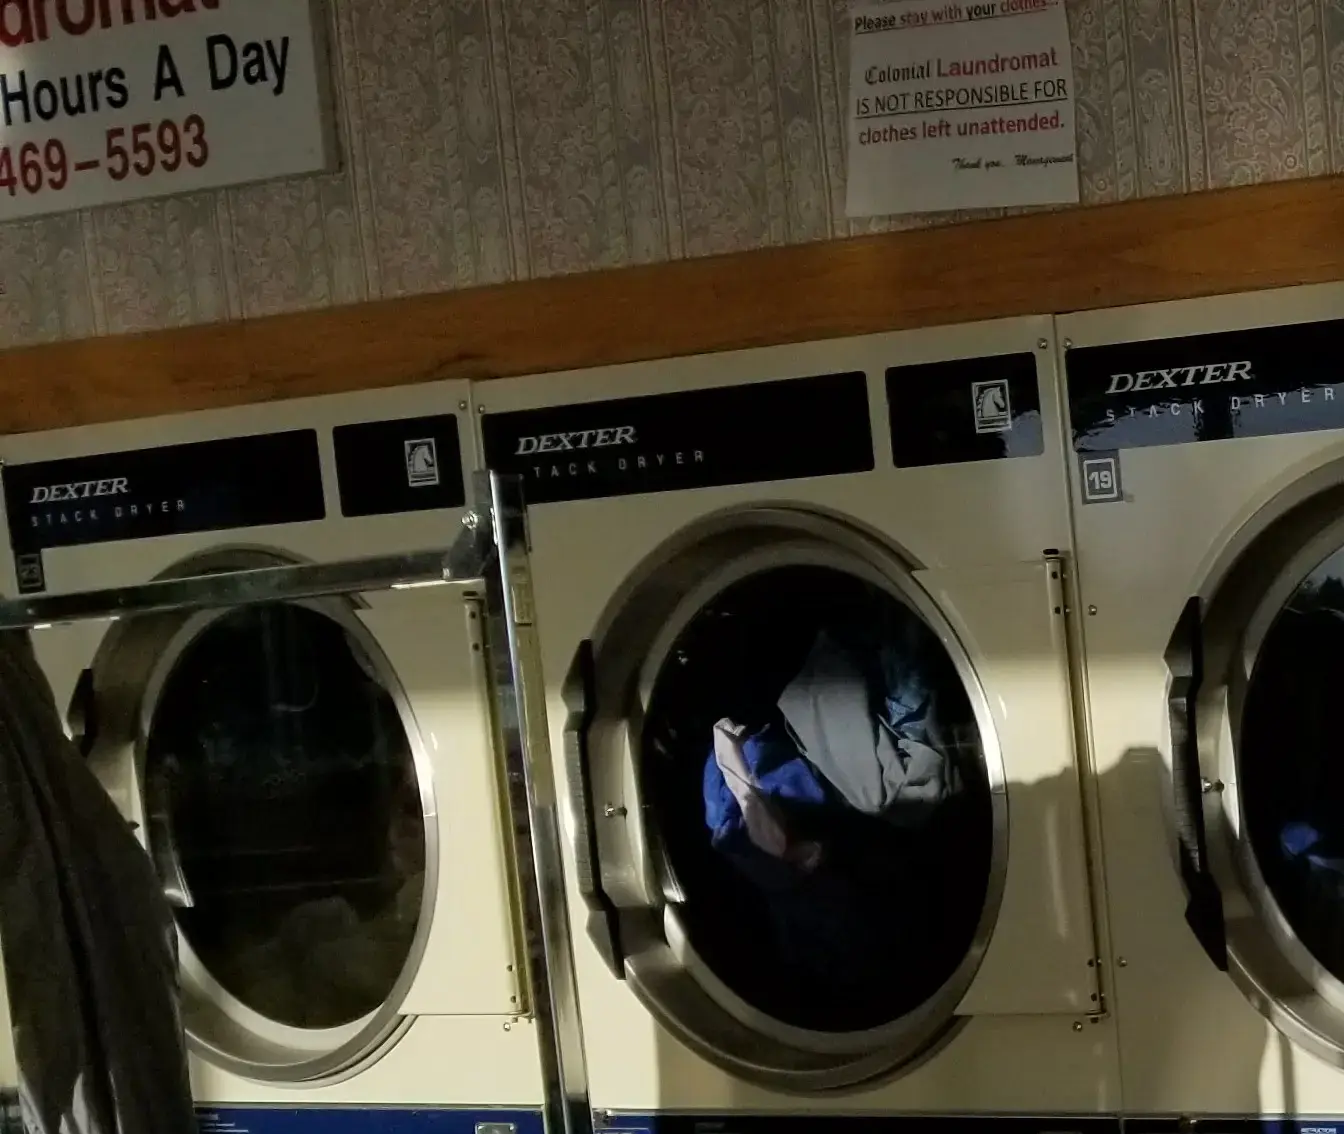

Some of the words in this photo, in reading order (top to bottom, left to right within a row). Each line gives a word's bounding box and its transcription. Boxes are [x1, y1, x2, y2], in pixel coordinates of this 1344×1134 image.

[855, 15, 896, 32] Please
[900, 11, 926, 26] stay
[932, 5, 962, 22] with
[966, 2, 996, 22] your
[0, 67, 129, 125] Hours
[154, 44, 185, 101] A
[206, 34, 289, 96] Day
[864, 59, 931, 85] Colonial
[937, 47, 1058, 77] Laundromat
[856, 97, 869, 115] IS
[875, 92, 910, 113] NOT
[914, 82, 1028, 109] RESPONSIBLE
[1034, 79, 1067, 99] FOR
[858, 124, 917, 145] clothes
[922, 118, 951, 138] left
[957, 110, 1065, 137] unattended.
[1105, 360, 1253, 395] DEXTER
[1106, 398, 1205, 423] STACK
[1231, 387, 1335, 411] DRYER
[516, 425, 638, 456] DEXTER
[533, 460, 598, 479] TACK
[617, 449, 705, 470] DRYER
[1088, 469, 1113, 491] 19
[29, 477, 129, 504] DEXTER
[31, 508, 99, 527] STACK
[114, 499, 185, 518] DRYER
